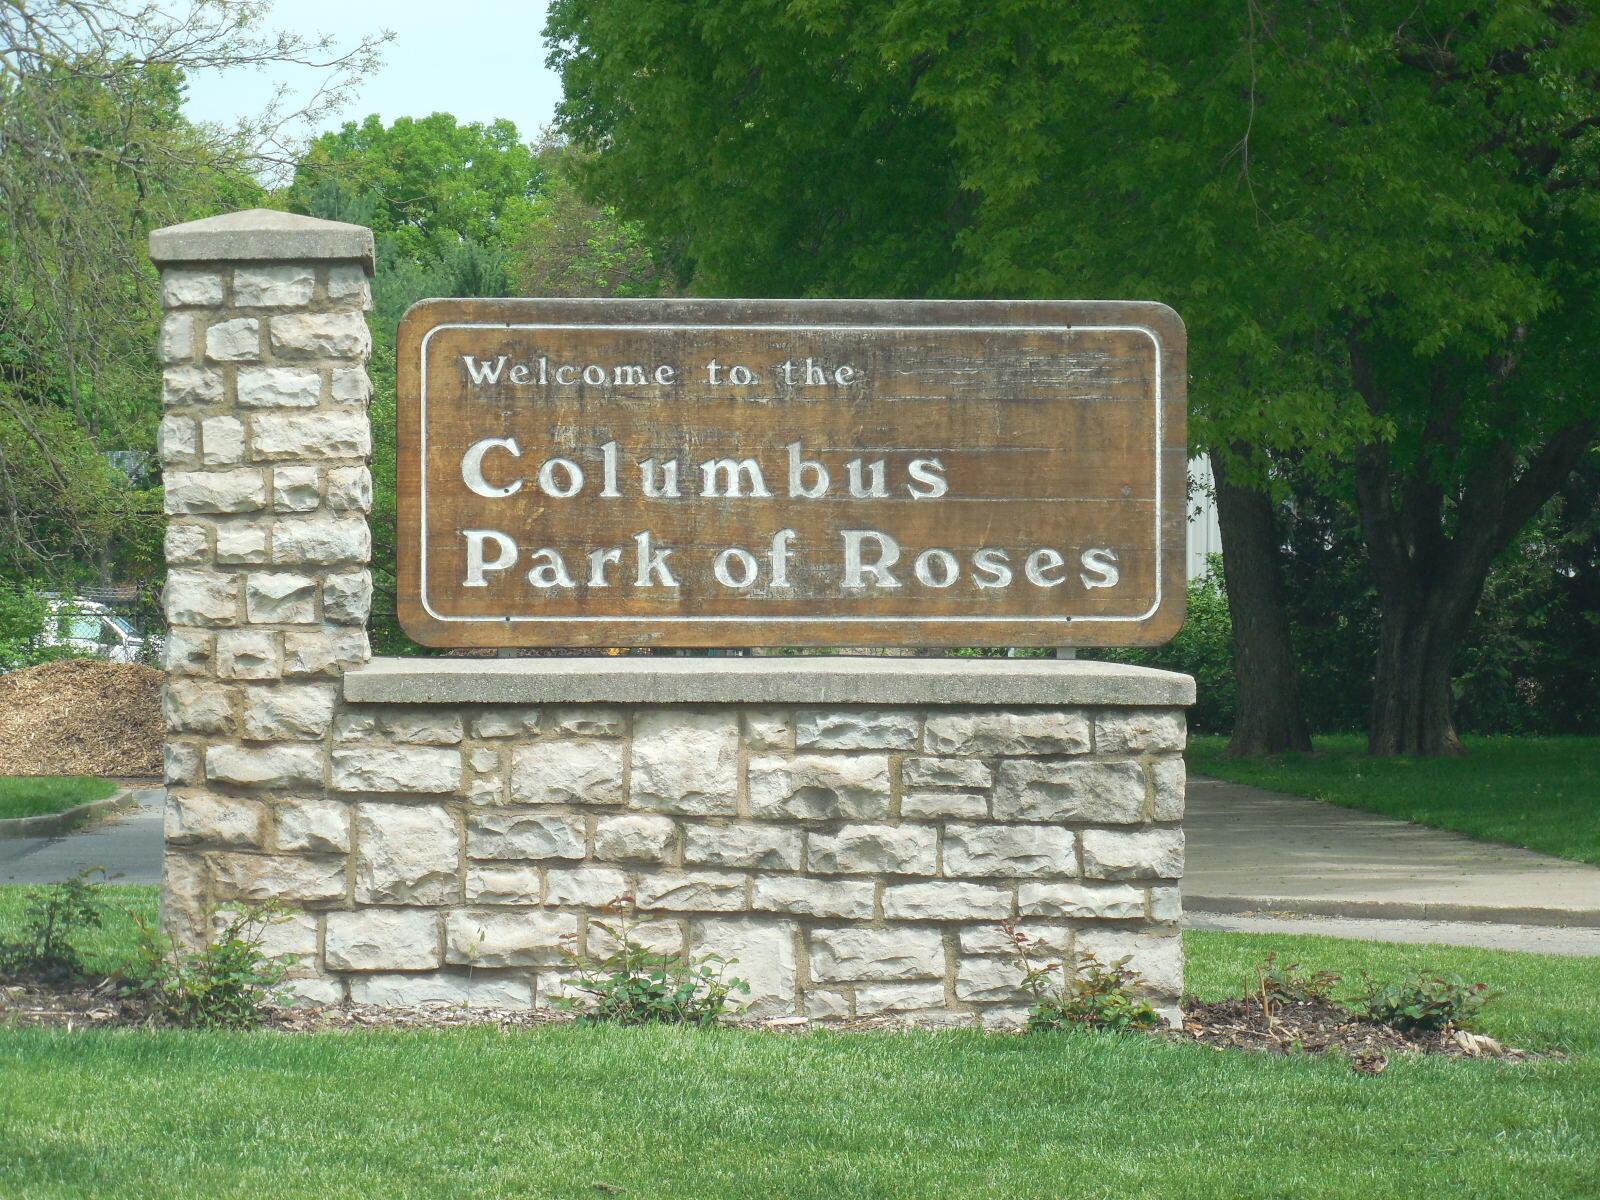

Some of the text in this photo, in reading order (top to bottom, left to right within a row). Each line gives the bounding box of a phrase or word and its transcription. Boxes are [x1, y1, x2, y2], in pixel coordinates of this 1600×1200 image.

[462, 354, 856, 387] Welcome to the
[460, 437, 949, 501] Columbus
[461, 528, 1121, 591] Park of Roses
